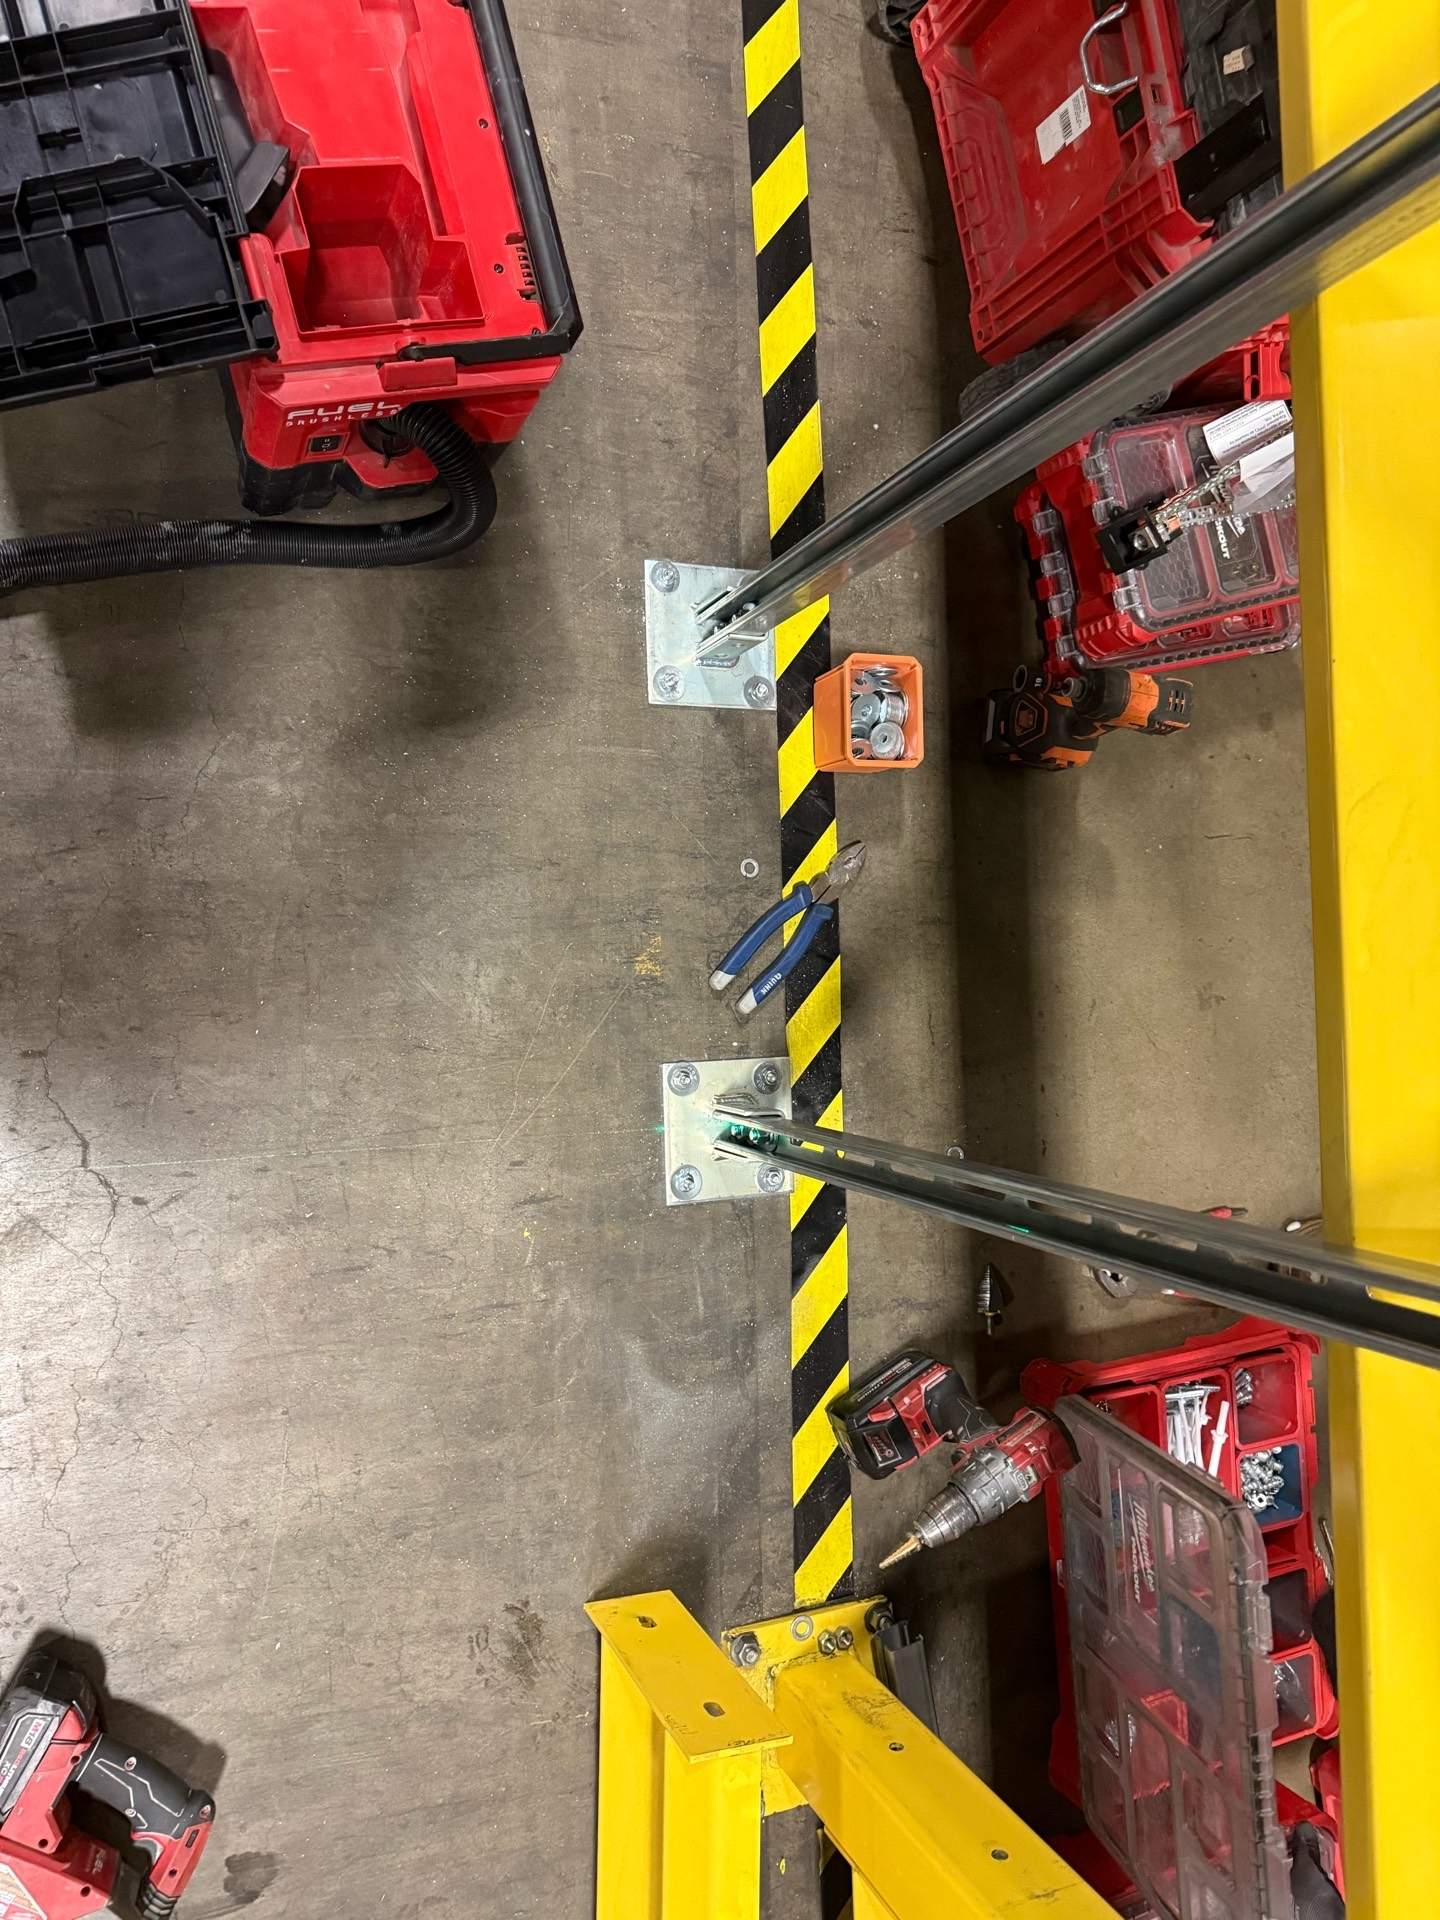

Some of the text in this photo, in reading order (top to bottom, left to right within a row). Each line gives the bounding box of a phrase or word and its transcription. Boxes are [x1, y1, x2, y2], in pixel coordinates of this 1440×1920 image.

[287, 401, 400, 420] FUEL
[1133, 1501, 1154, 1591] Milwaukee
[22, 1719, 44, 1747] M18
